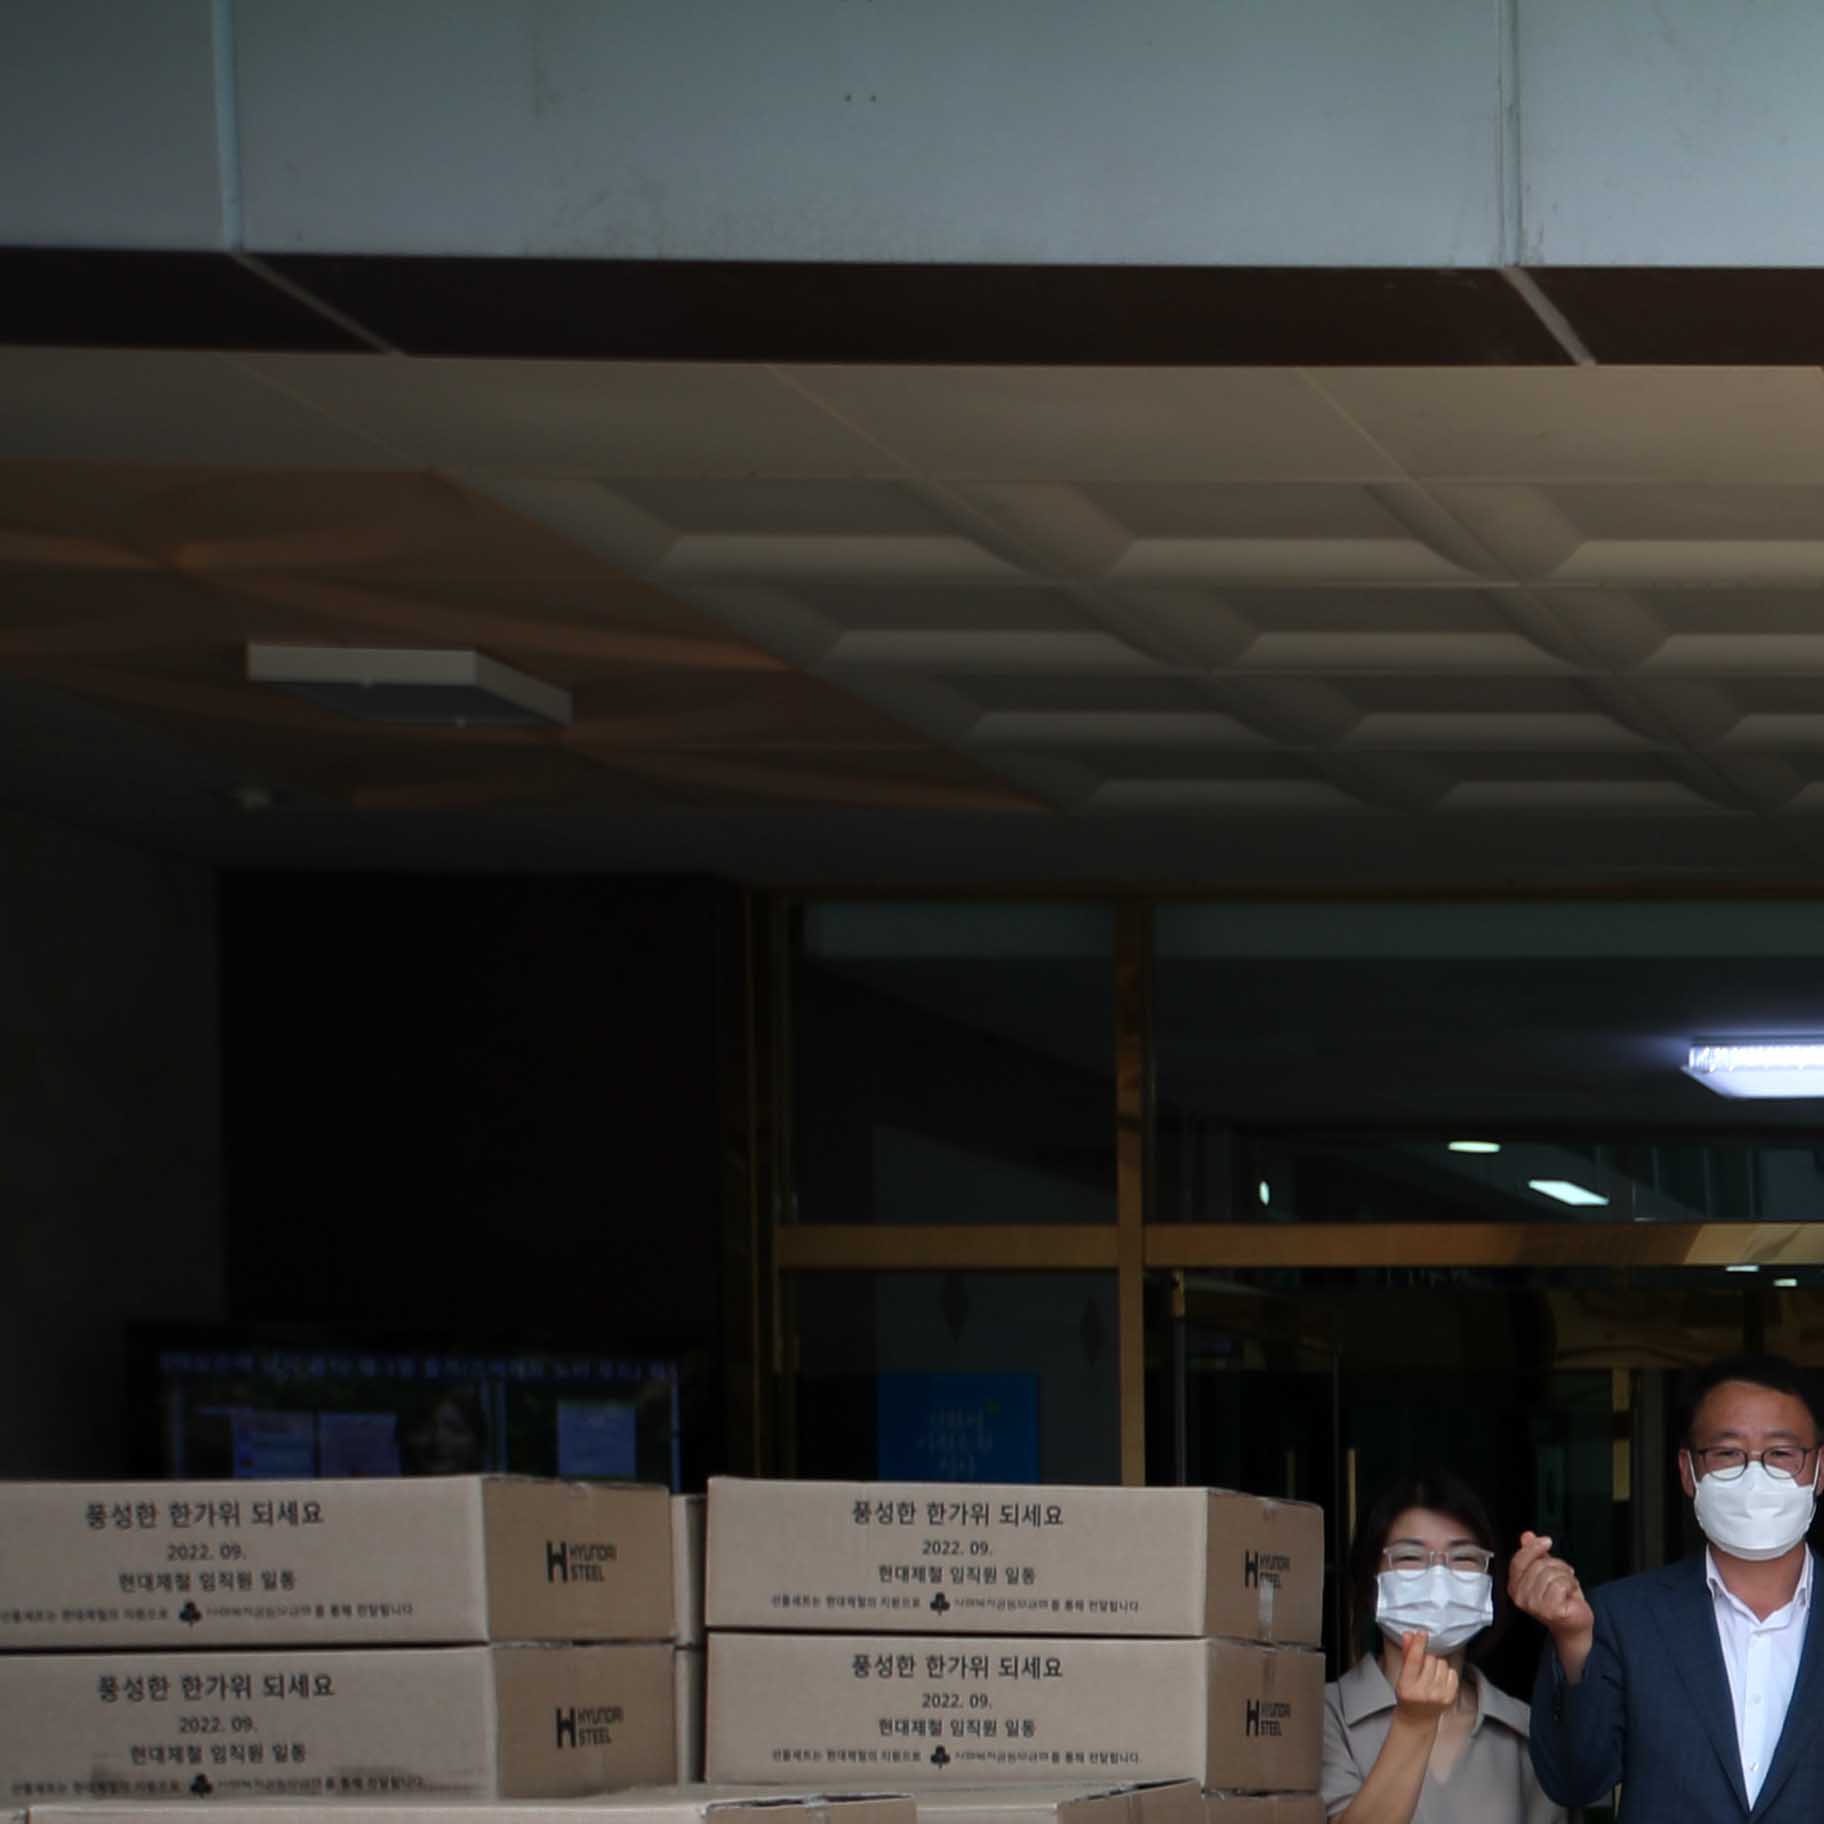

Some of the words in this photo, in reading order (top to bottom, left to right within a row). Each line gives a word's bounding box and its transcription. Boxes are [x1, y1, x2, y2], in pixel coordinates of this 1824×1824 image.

[85, 1501, 159, 1532] 풍성한
[168, 1500, 242, 1530] 한가위
[251, 1500, 325, 1528] 되세요
[852, 1500, 918, 1527] 풍성한
[926, 1501, 991, 1528] 한가위
[999, 1503, 1066, 1529] 되세요
